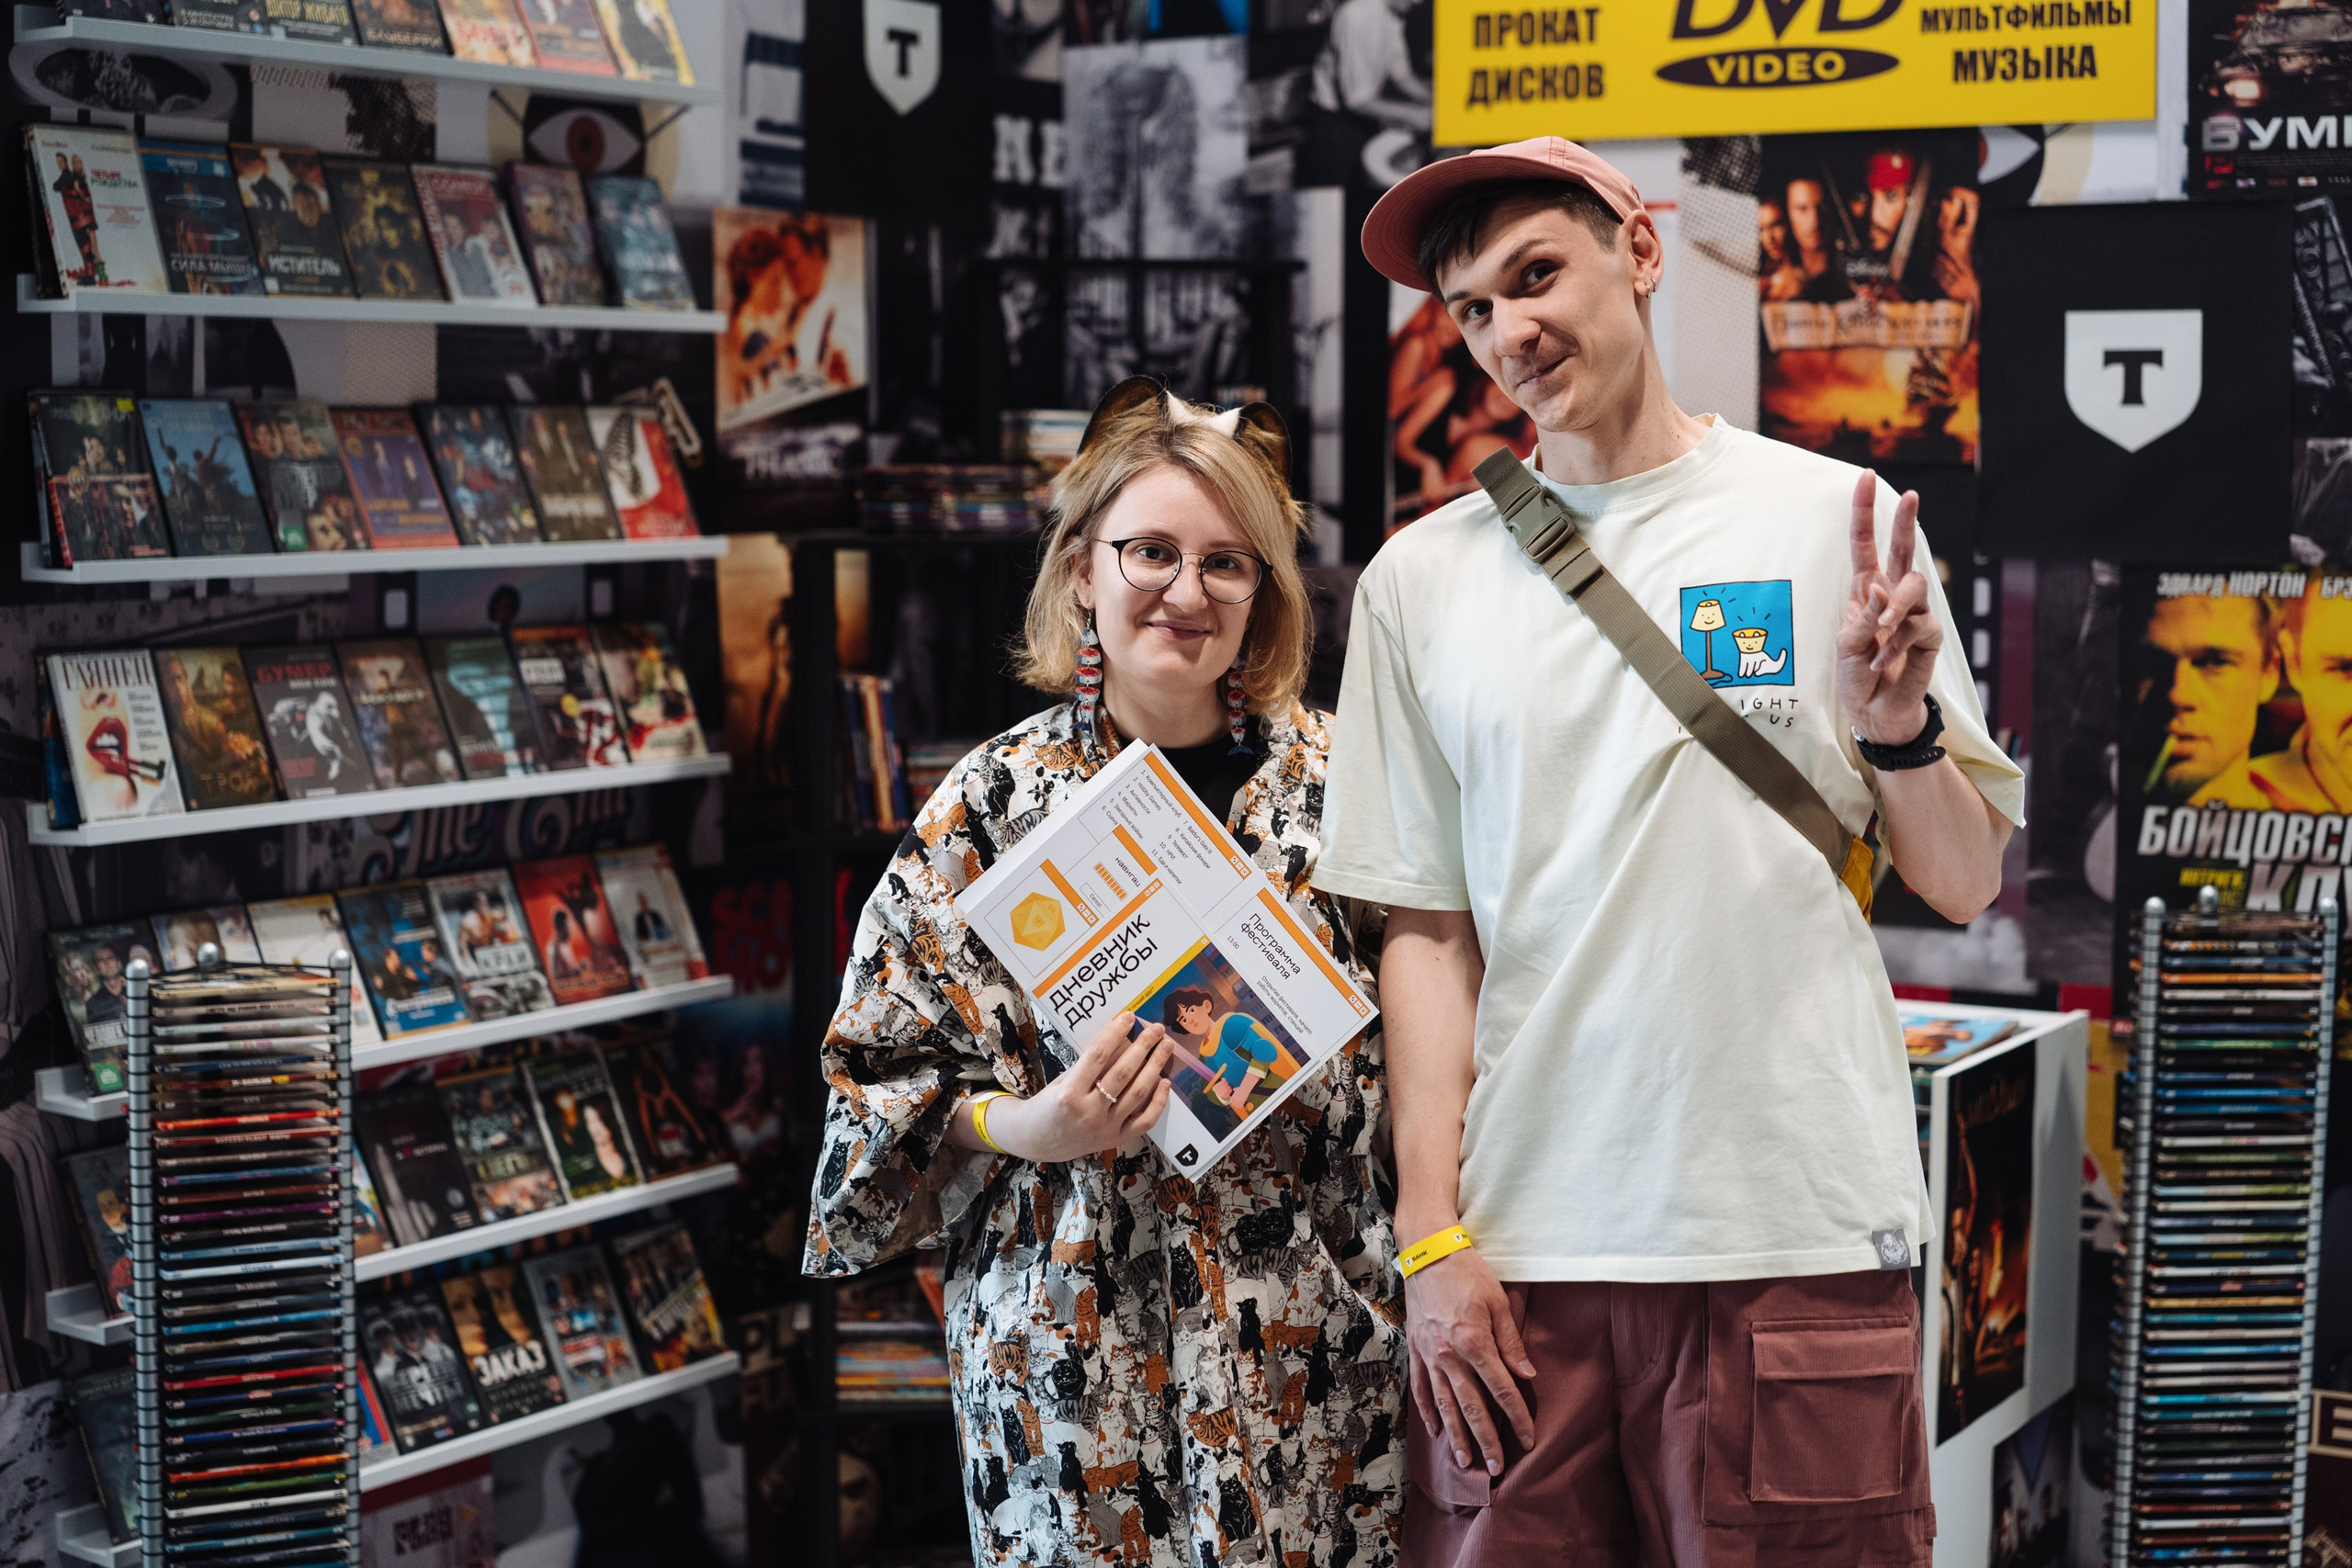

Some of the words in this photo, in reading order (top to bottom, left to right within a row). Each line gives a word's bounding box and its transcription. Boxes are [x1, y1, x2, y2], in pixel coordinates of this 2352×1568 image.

[1475, 8, 1600, 49] ПРОКАТ
[1670, 0, 1904, 39] DVD
[1921, 0, 2132, 34] МУЛЬТФИЛЬМЫ
[1707, 51, 1846, 85] VIDEO
[1953, 44, 2098, 83] МУЗЫКА
[1467, 64, 1604, 109] ДИСКОВ
[2157, 572, 2226, 600] ЭДВАРД
[2228, 570, 2307, 598] НОРТОН
[1740, 698, 1798, 710] IGHT
[1121, 795, 1138, 817] Маркеты
[1128, 788, 1151, 815] Активности
[1136, 781, 1150, 797] Hobby
[1148, 795, 1161, 811] Games
[1145, 773, 1173, 807] Компьютерный
[1170, 806, 1182, 818] клуб
[1105, 809, 1118, 826] Сцена
[1113, 802, 1132, 826] Звездные
[1129, 823, 1144, 840] войны
[1171, 839, 1188, 859] Телемост
[1179, 831, 1198, 854] Китайские
[1195, 852, 1211, 869] фонари
[1186, 824, 1202, 842] Baldur's
[1199, 840, 1208, 851] Gate
[1157, 855, 1166, 865] Еда
[1166, 866, 1182, 885] напитки
[1088, 892, 1102, 908] Cancel
[1227, 934, 1239, 949] 13:00
[1240, 922, 1291, 979] фестиваля
[1248, 912, 1301, 975] Программа
[1048, 913, 1150, 1014] дневник
[1063, 937, 1158, 1032] дружбы
[1255, 979, 1272, 997] работы
[1269, 995, 1288, 1017] маркетов,
[1286, 1015, 1304, 1033] станций
[1261, 975, 1280, 997] Открытие
[1277, 995, 1299, 1021] фестиваля,
[1297, 1018, 1312, 1034] начало
[1412, 1250, 1429, 1261] БАНК
[473, 1340, 548, 1388] ЗАКАЗ
